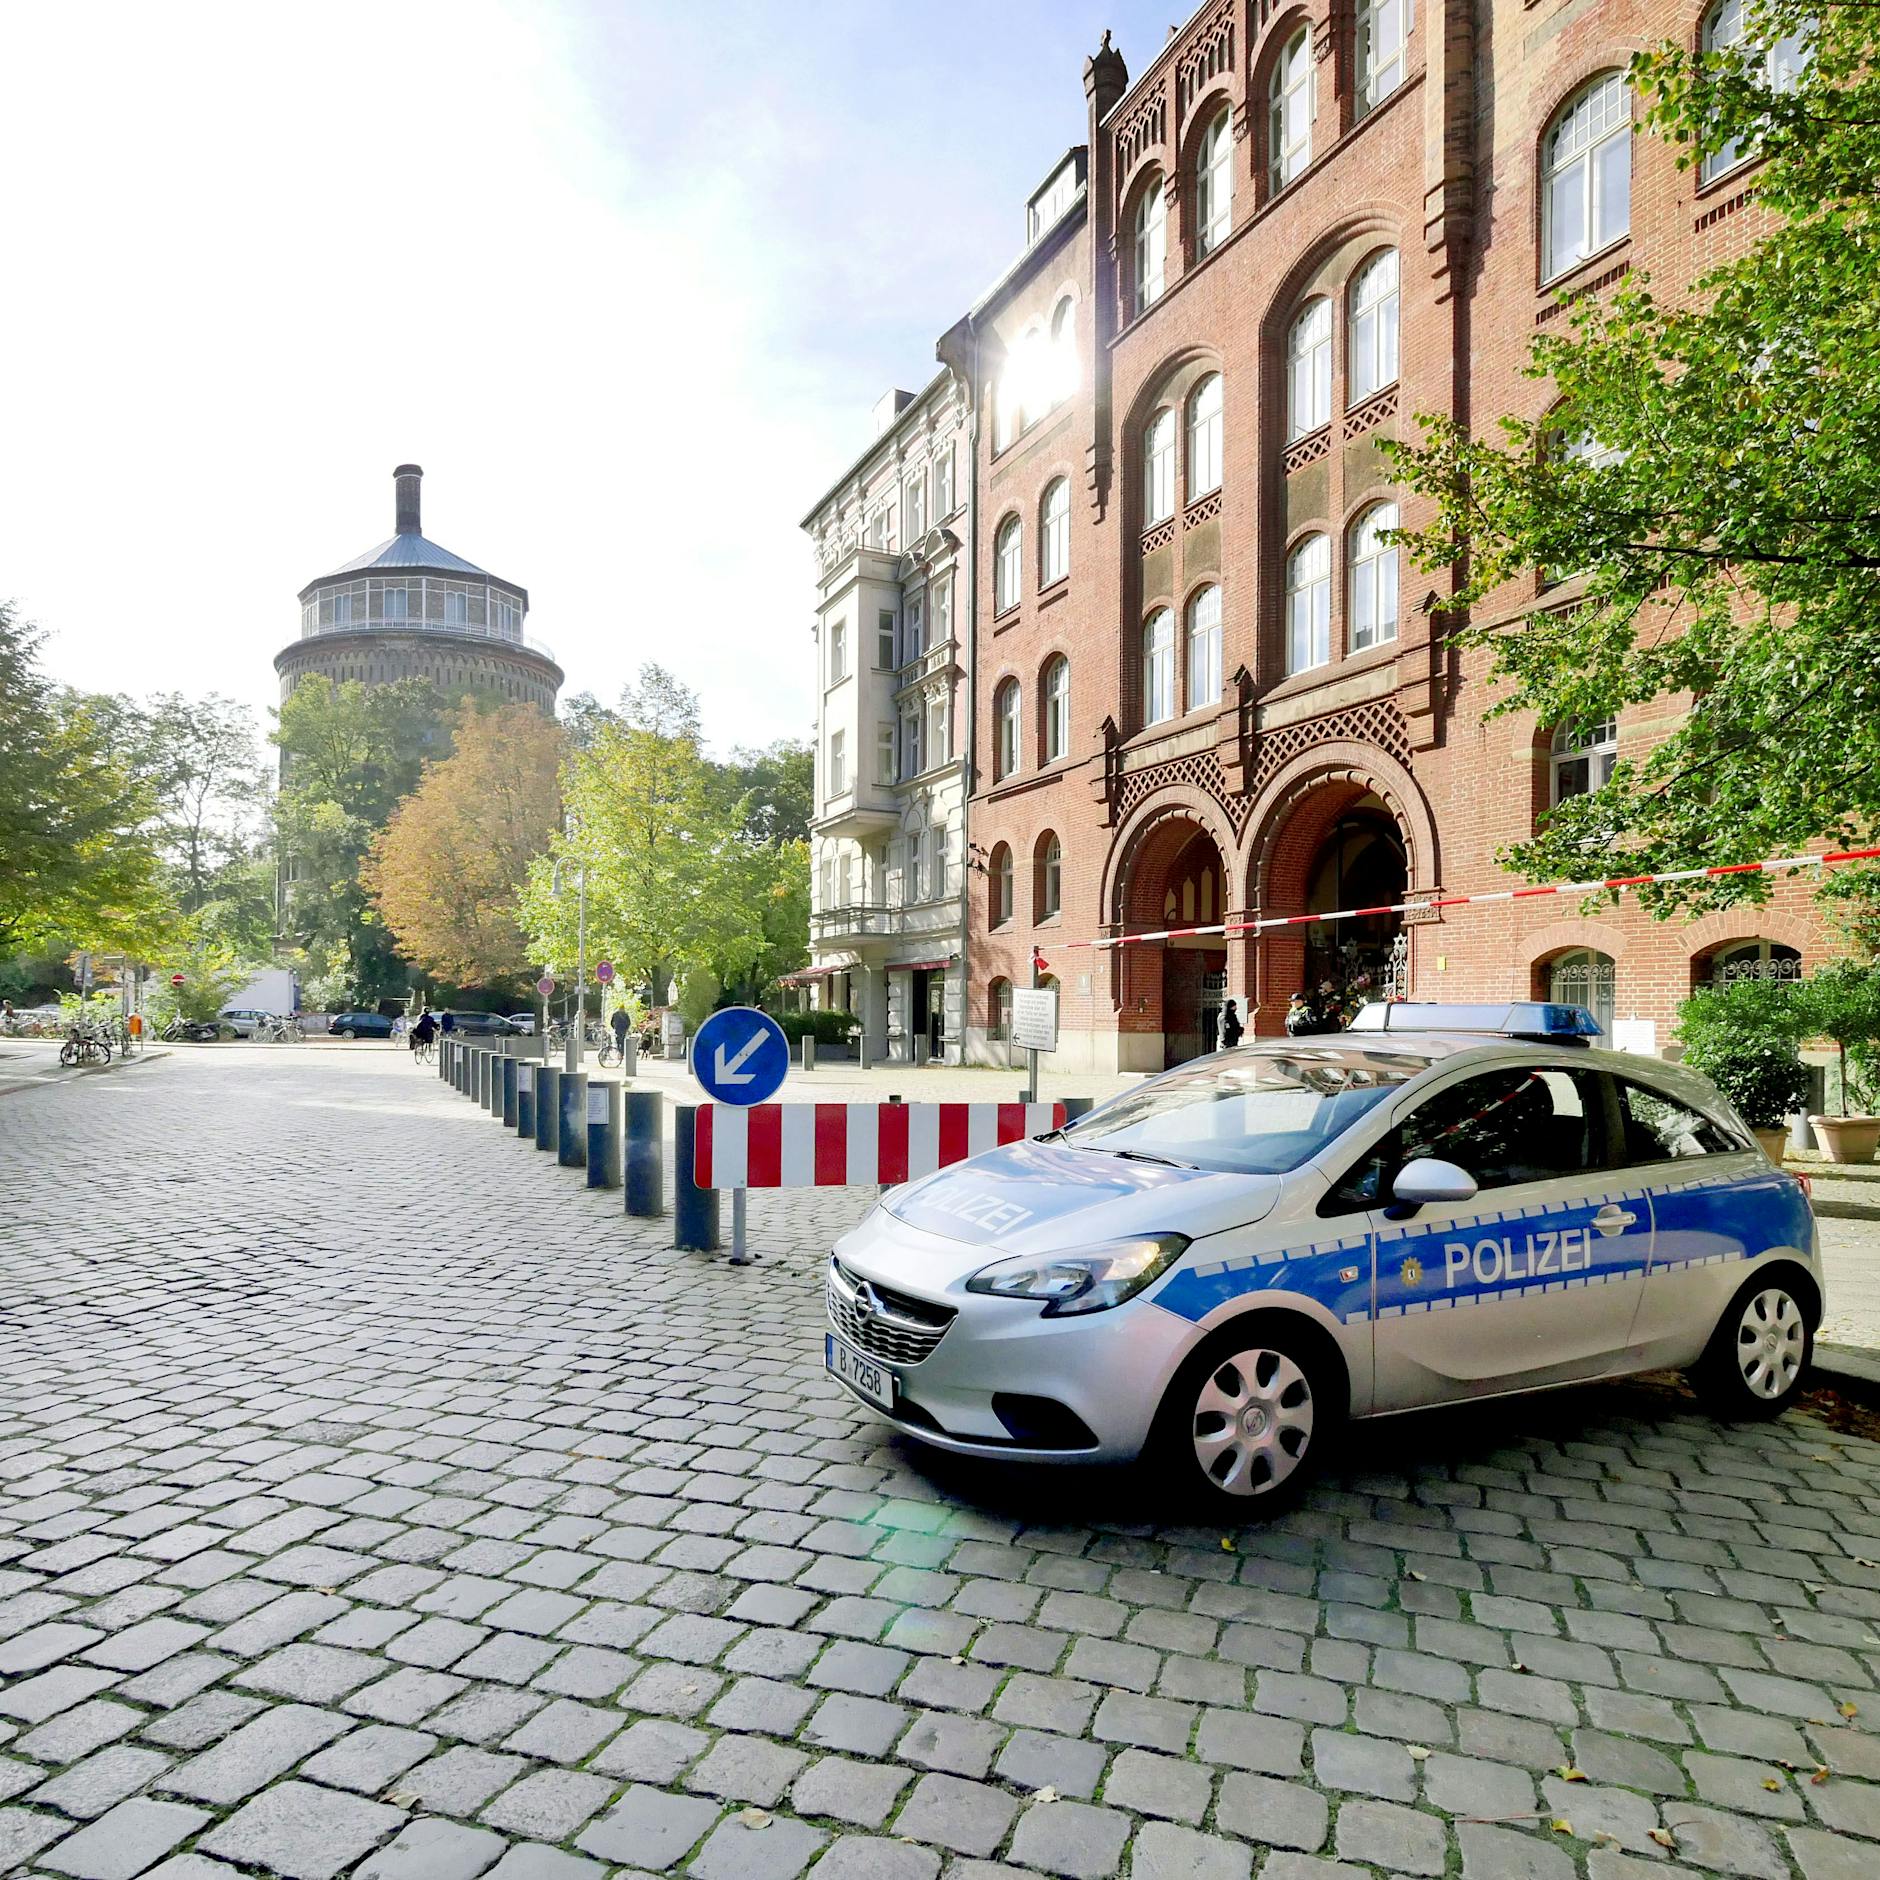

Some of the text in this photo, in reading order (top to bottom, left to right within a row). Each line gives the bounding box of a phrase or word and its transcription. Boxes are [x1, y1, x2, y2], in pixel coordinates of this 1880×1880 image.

[912, 1184, 1034, 1235] OLIZEI
[1444, 1228, 1591, 1288] POLIZEI
[840, 1347, 881, 1396] B 7258
